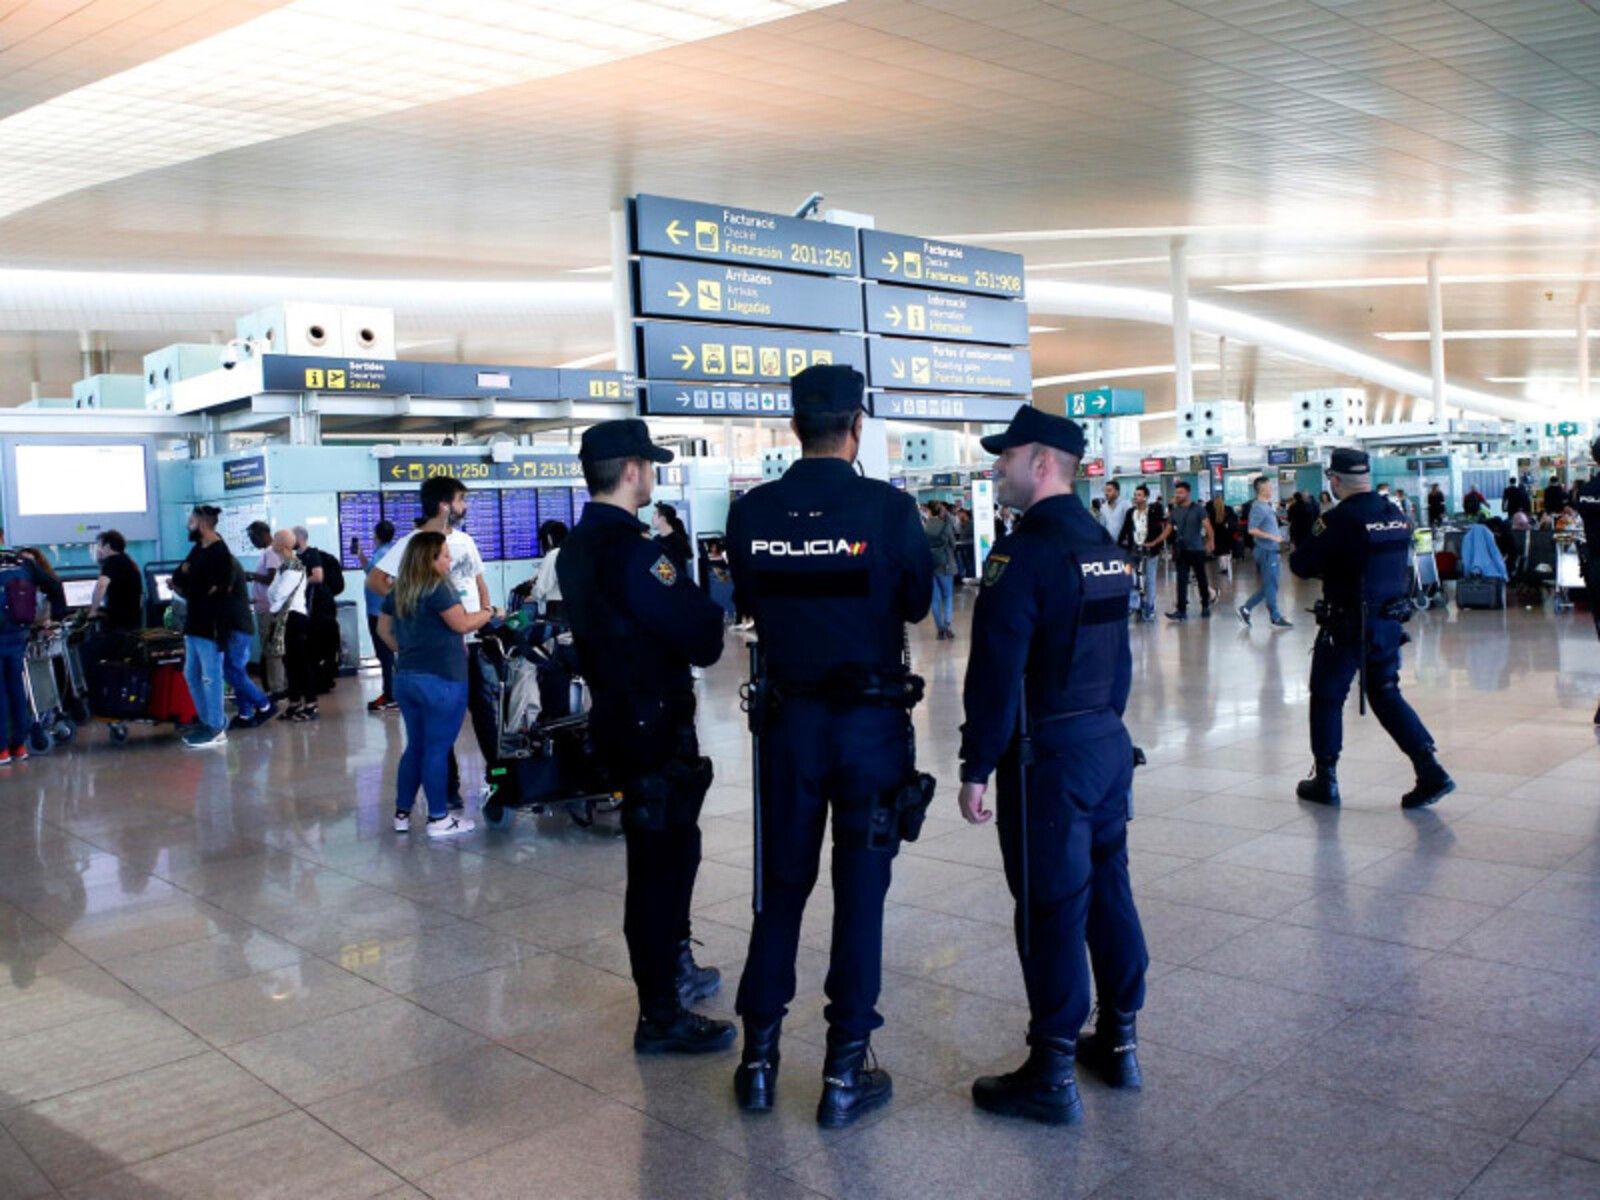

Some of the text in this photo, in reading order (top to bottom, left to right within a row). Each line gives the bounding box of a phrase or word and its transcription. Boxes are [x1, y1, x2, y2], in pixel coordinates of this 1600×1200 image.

[723, 210, 776, 230] Facturació
[725, 239, 783, 260] Facturación
[790, 243, 852, 269] 201:250
[725, 267, 773, 286] Arribades
[728, 297, 771, 316] Llegadas
[428, 463, 490, 480] 201:250
[751, 539, 852, 556] POLICIA
